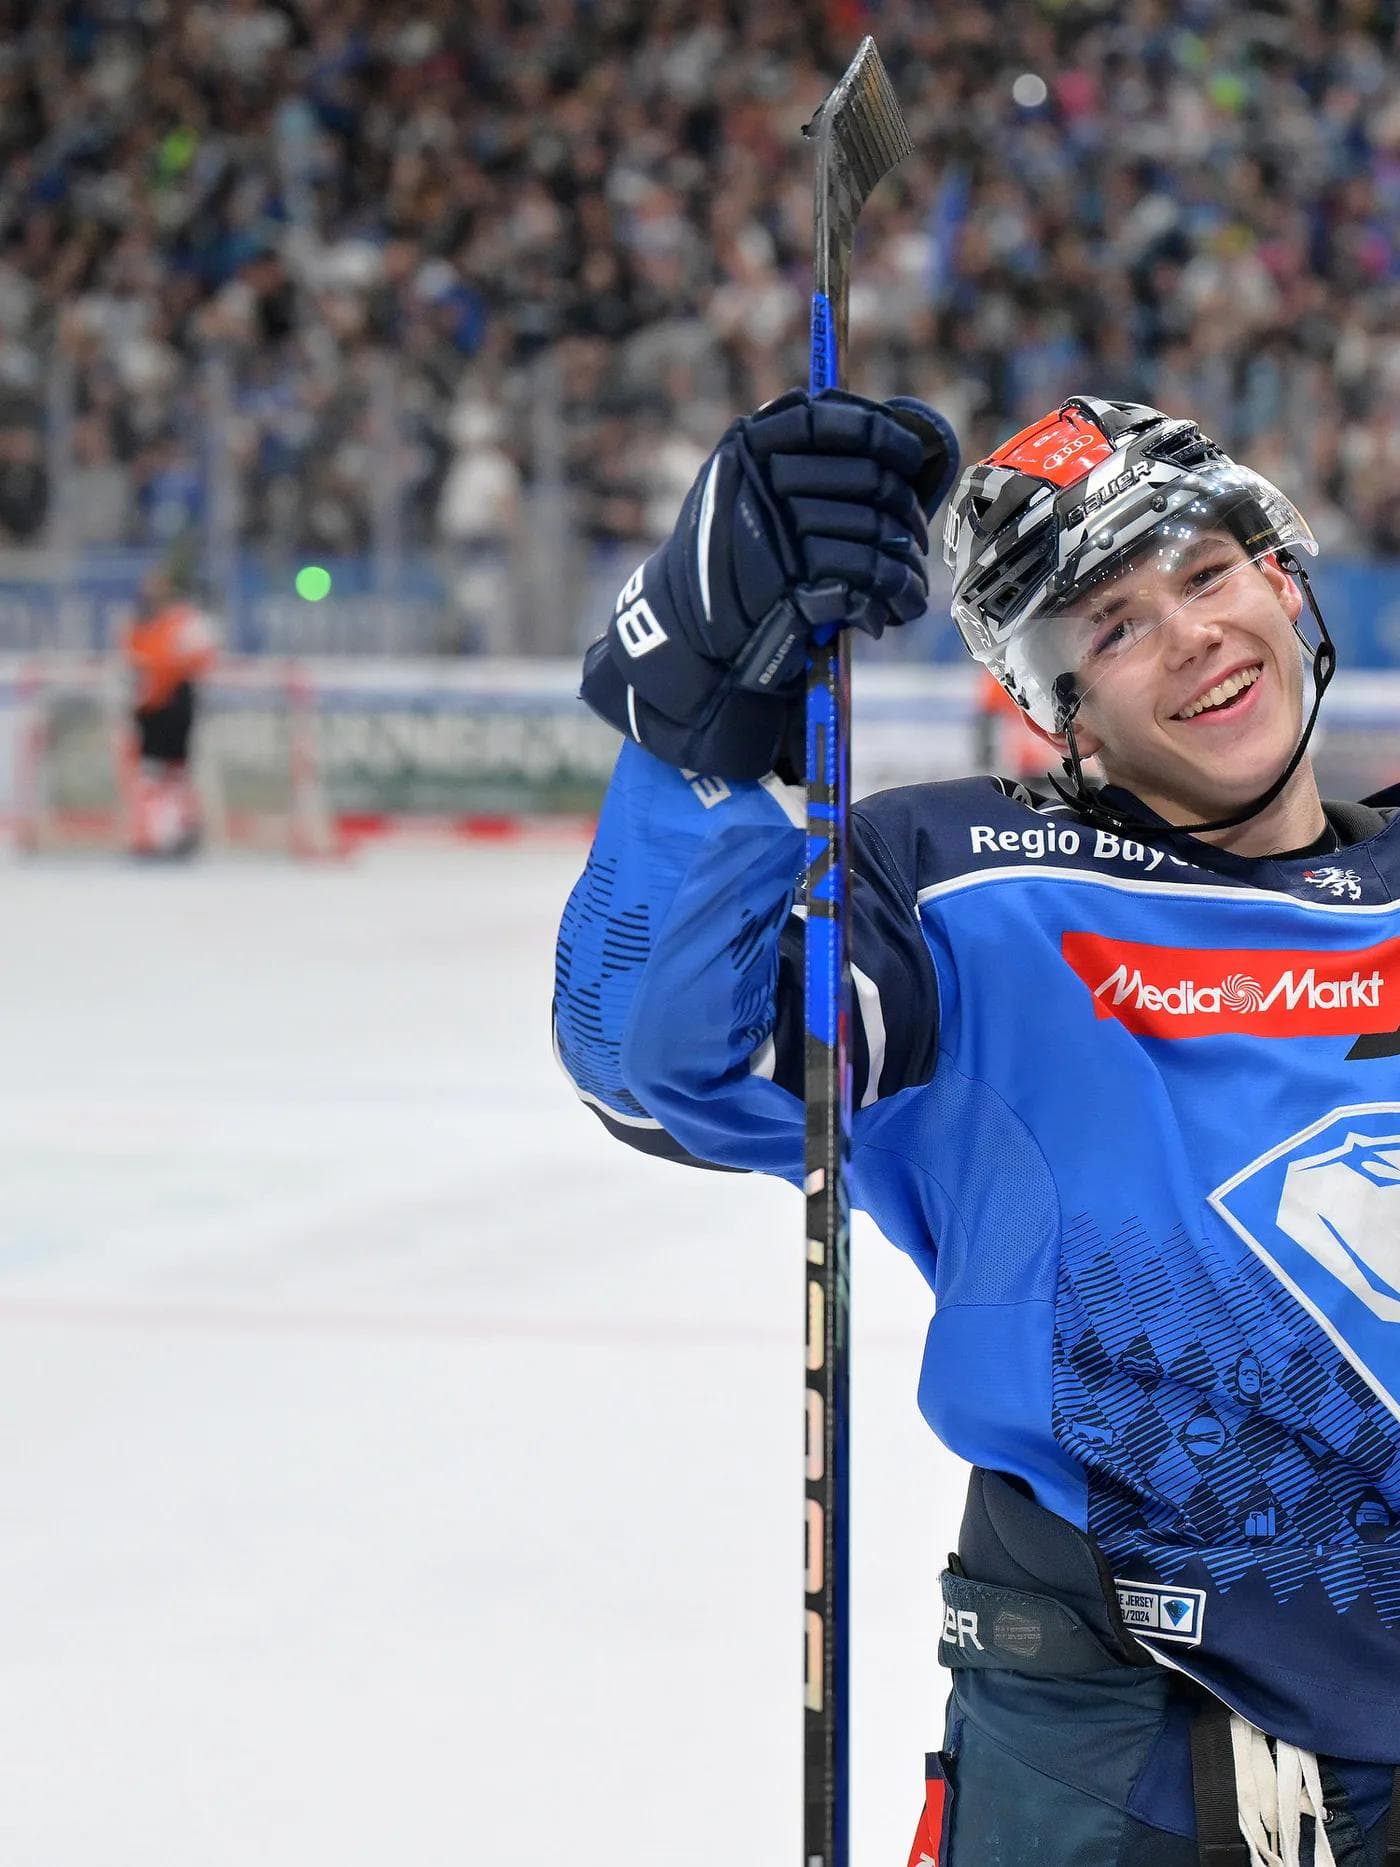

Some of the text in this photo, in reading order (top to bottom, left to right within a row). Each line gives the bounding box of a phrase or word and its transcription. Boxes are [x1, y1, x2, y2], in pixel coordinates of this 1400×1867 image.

[969, 822, 1217, 873] Regio Bay
[1126, 1594, 1154, 1609] JERSEY
